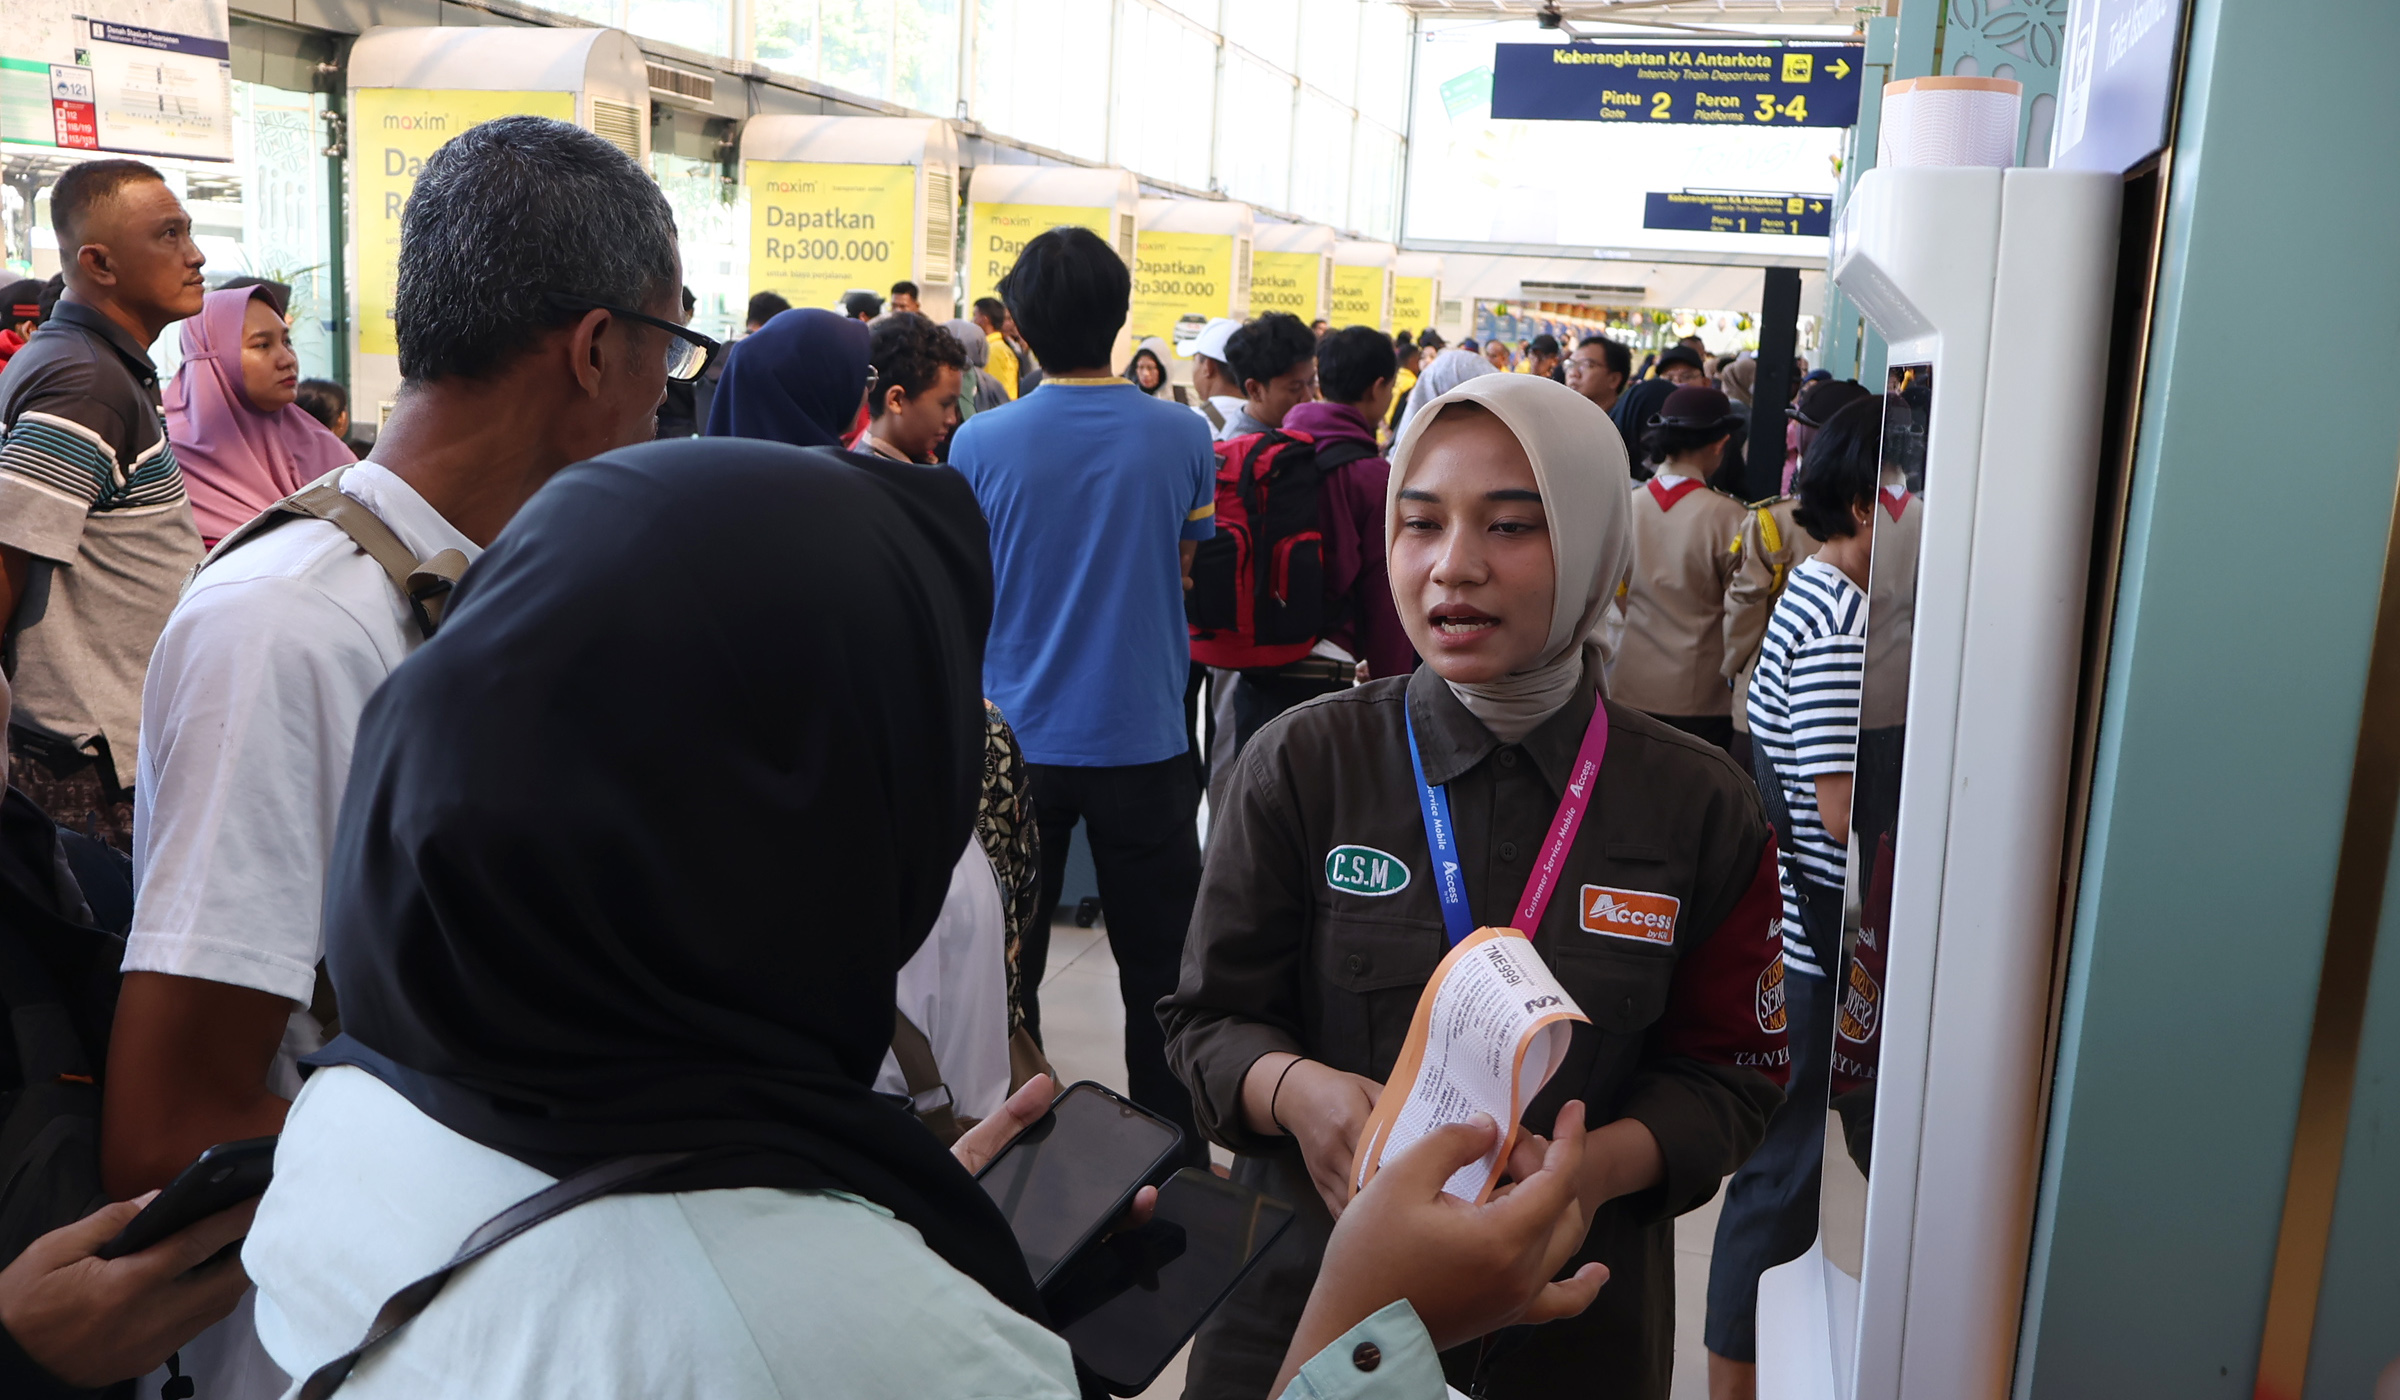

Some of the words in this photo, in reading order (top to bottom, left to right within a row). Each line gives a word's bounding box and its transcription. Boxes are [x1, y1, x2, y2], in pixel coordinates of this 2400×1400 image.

[1553, 49, 1665, 68] Keberangkatan
[1668, 52, 1692, 66] KA
[1695, 53, 1772, 68] Antarkota
[1637, 68, 1680, 81] Intercity
[1682, 69, 1708, 81] Train
[1710, 70, 1770, 82] Departures
[69, 83, 88, 97] 121
[1602, 90, 1641, 106] Pintu
[1650, 92, 1672, 119] 2
[1695, 92, 1740, 107] Peron
[66, 110, 78, 120] 112
[383, 112, 446, 131] maxim
[1600, 107, 1626, 119] Gate
[1693, 109, 1744, 122] Platforms
[766, 179, 816, 193] maxim
[766, 206, 875, 231] Dapatkan
[990, 214, 1031, 228] maxim
[1738, 218, 1747, 232] 1
[1760, 218, 1785, 228] Peron
[1790, 220, 1799, 235] 1
[1134, 258, 1206, 276] Dapatkan
[1570, 760, 1592, 799] Access
[1434, 818, 1445, 851] Mobile
[1332, 853, 1390, 890] C.S.M
[1524, 870, 1549, 920] Customer
[1543, 839, 1564, 874] Service
[1559, 806, 1577, 840] Mobile
[1442, 861, 1459, 904] Access
[1589, 894, 1672, 930] Access
[1483, 944, 1524, 988] 7ME999I
